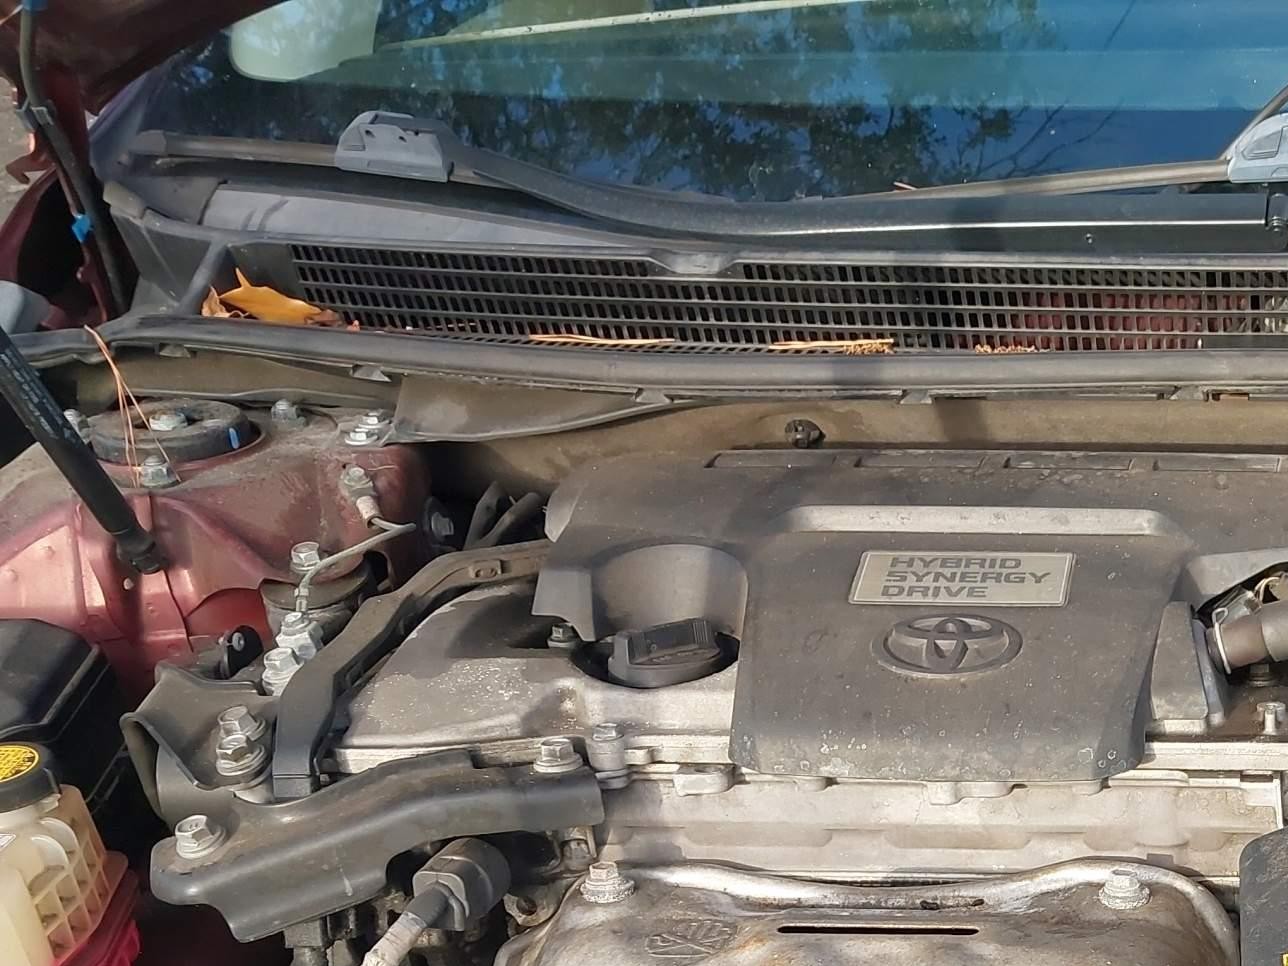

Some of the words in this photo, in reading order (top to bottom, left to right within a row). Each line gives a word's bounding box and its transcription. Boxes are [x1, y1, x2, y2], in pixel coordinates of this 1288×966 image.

[890, 557, 1021, 569] HYBRID
[885, 571, 1050, 584] SYNERGY
[881, 585, 988, 598] DRIVE
